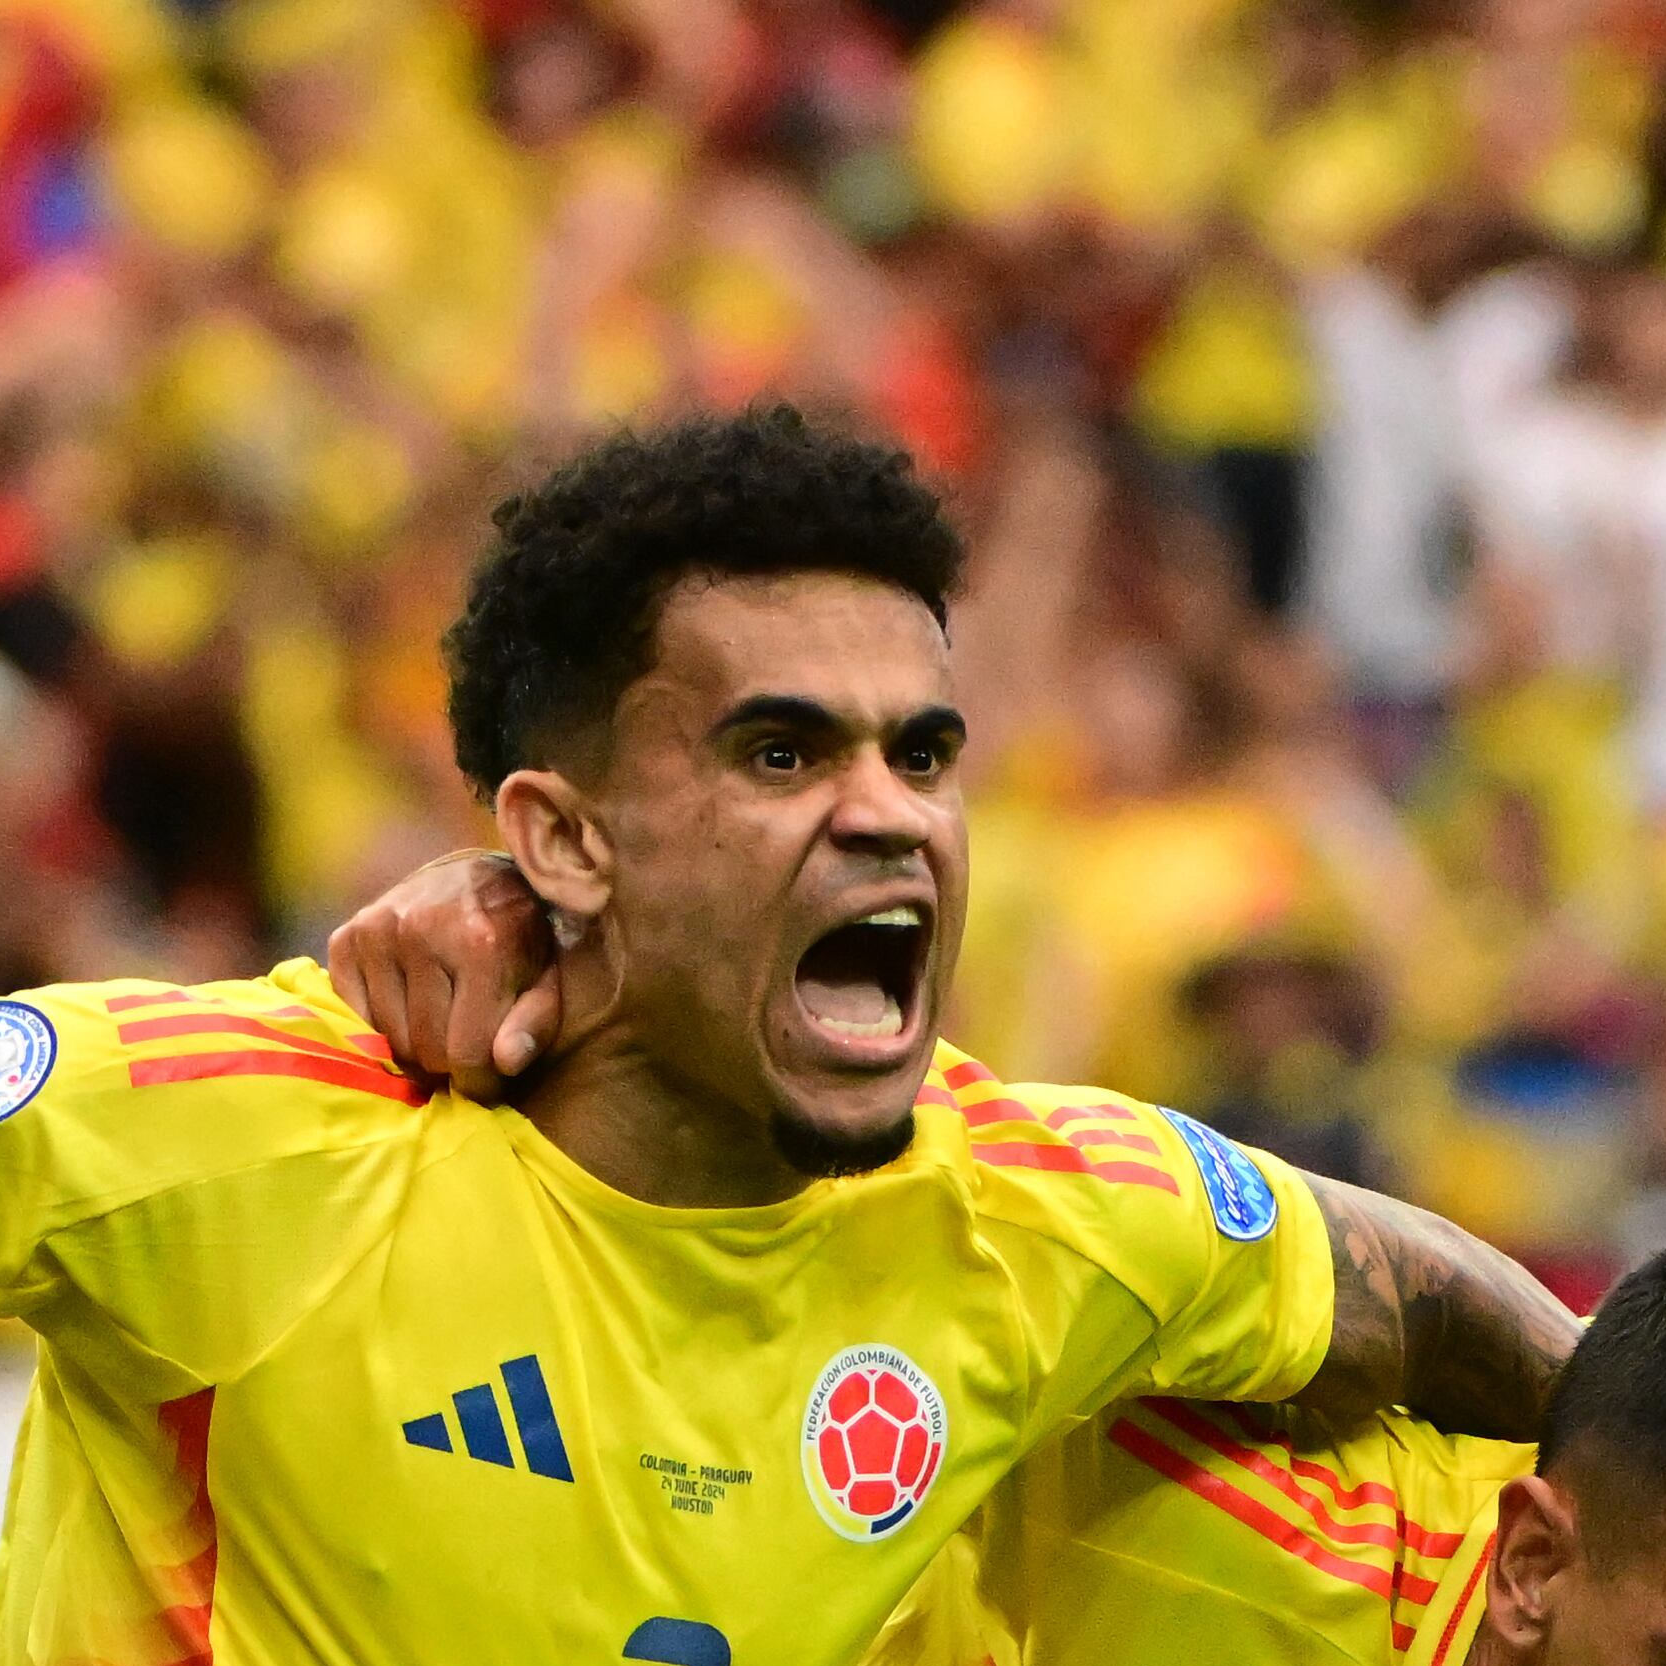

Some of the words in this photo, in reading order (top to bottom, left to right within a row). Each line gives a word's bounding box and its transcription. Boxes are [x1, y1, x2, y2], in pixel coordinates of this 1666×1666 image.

[840, 1350, 909, 1377] COLOMBIANA
[907, 1370, 923, 1389] DE
[639, 1453, 687, 1477] COLOMBIA
[699, 1465, 753, 1485] PARAGUAY
[661, 1475, 673, 1491] 24
[674, 1478, 698, 1496] JUNE
[701, 1482, 725, 1500] 2024
[671, 1495, 714, 1515] HOUSTON
